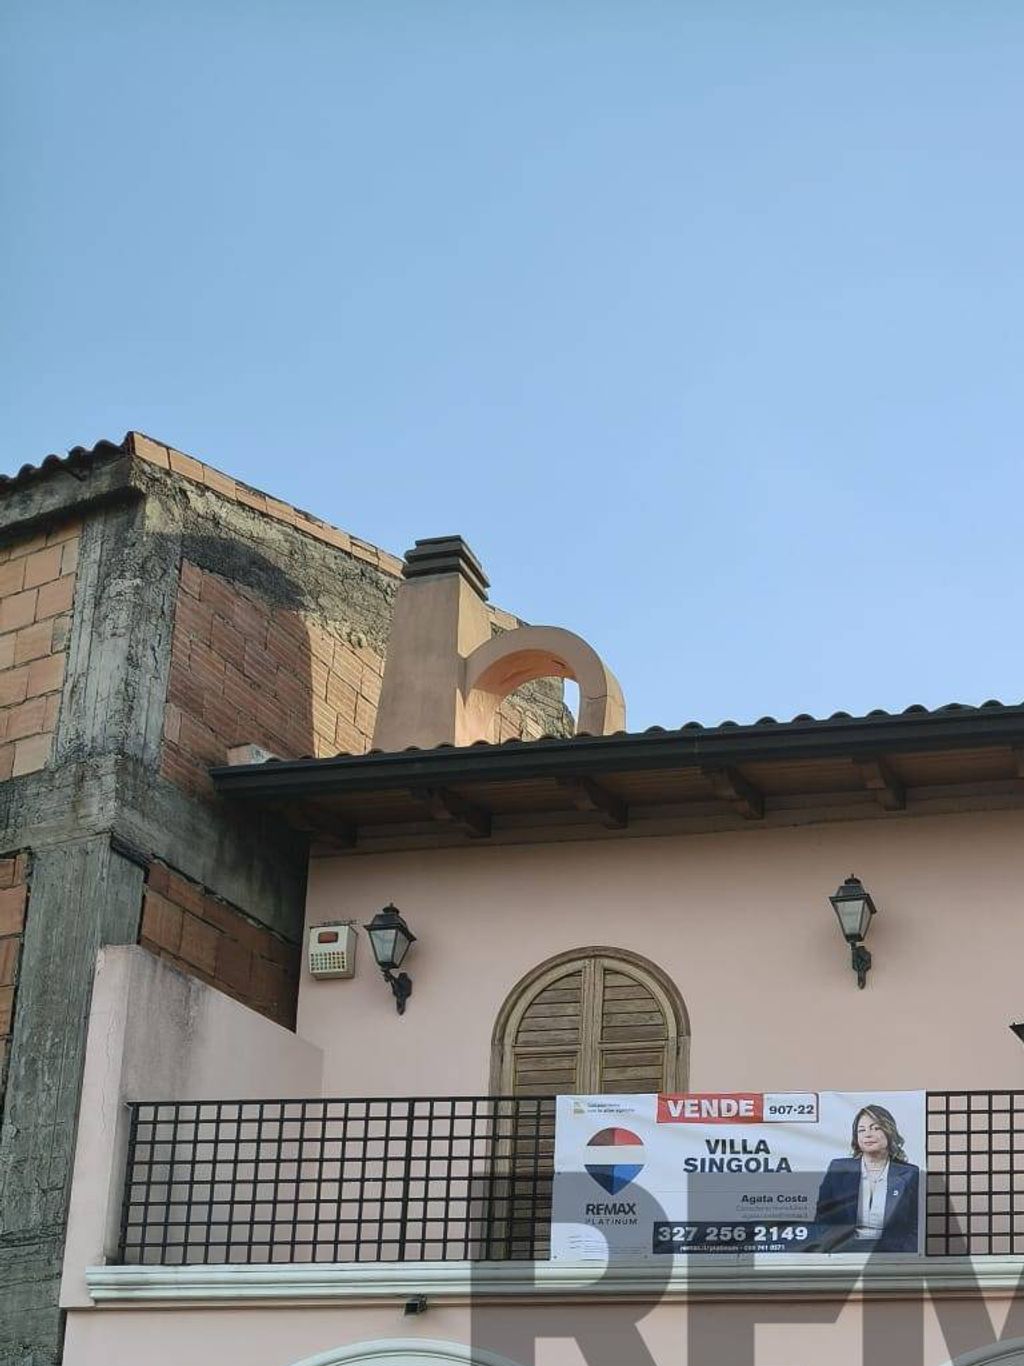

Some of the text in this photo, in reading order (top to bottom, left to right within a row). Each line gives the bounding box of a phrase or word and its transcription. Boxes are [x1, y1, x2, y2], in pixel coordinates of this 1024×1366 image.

[667, 1098, 755, 1118] VENDE
[705, 1139, 771, 1155] VILLA
[683, 1157, 792, 1173] SINGOLA
[741, 1194, 808, 1205] Agata Costa
[585, 1203, 636, 1215] REMAX
[585, 1218, 638, 1226] PLATINUM
[658, 1226, 808, 1241] 327 256 2149
